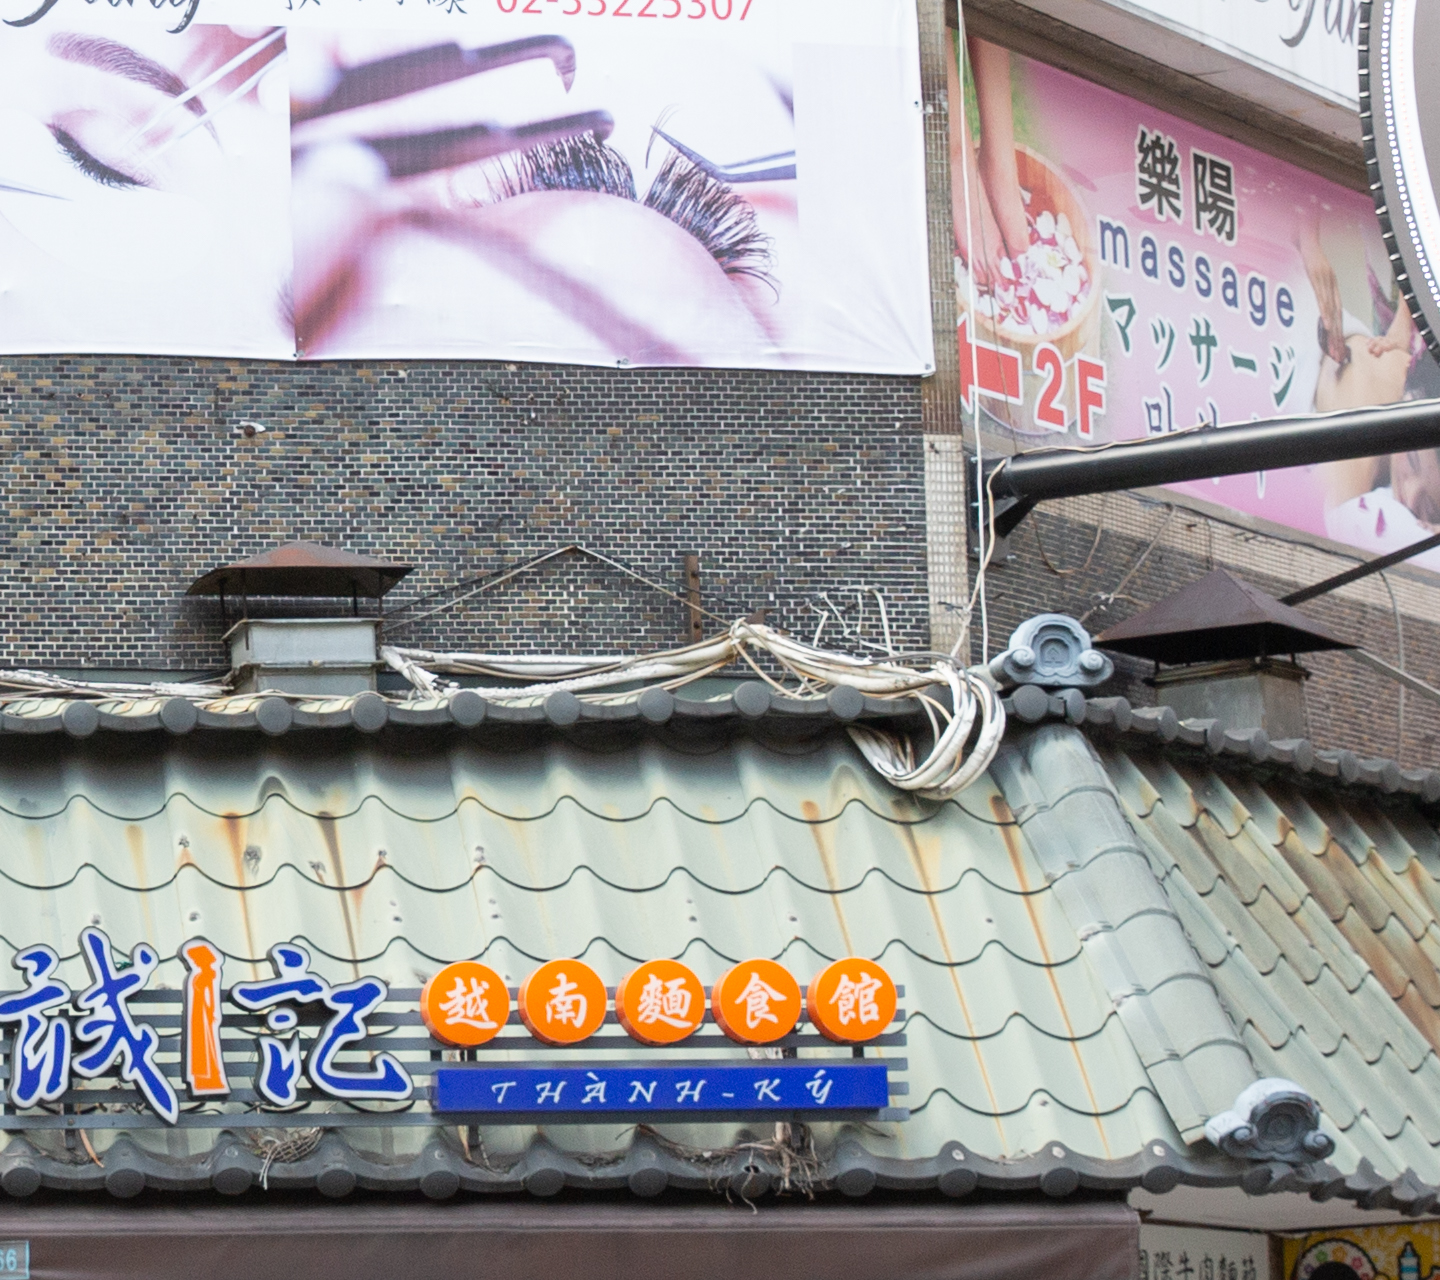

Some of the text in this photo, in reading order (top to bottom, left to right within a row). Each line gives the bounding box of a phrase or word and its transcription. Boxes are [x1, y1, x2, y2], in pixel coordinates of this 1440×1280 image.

[1136, 124, 1238, 245] 樂陽
[1098, 217, 1296, 329] massage
[1035, 343, 1106, 436] 2F
[1106, 292, 1296, 407] マッサージ
[438, 974, 885, 1034] 越南麵食館
